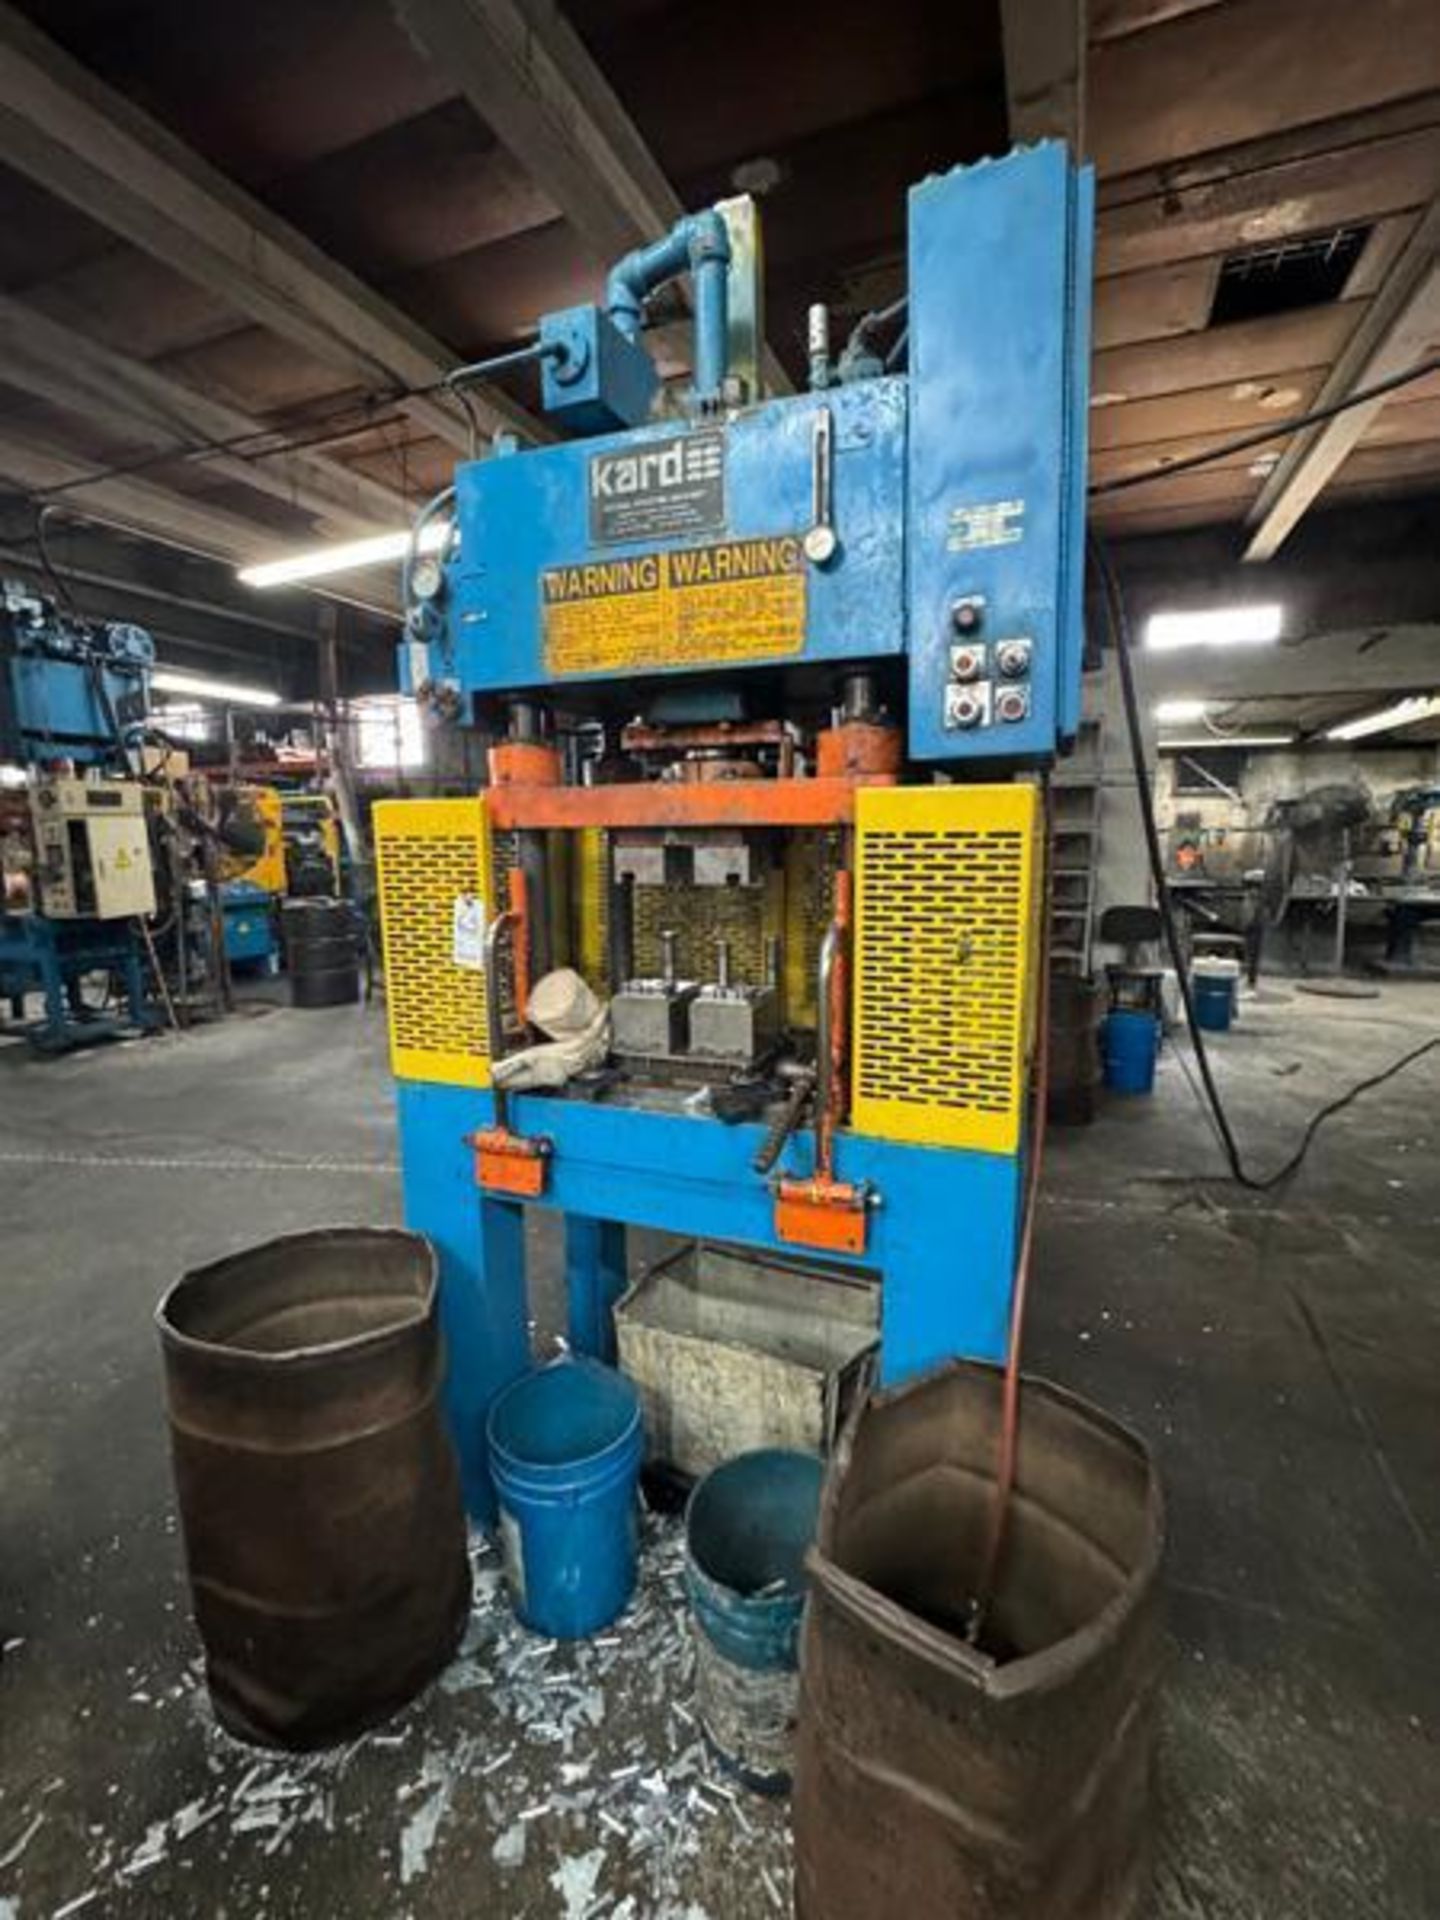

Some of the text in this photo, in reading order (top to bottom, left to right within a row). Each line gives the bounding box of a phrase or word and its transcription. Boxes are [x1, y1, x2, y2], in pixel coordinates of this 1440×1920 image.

[592, 440, 683, 498] kard
[547, 557, 657, 601] WARNING
[673, 538, 800, 584] WARNING
